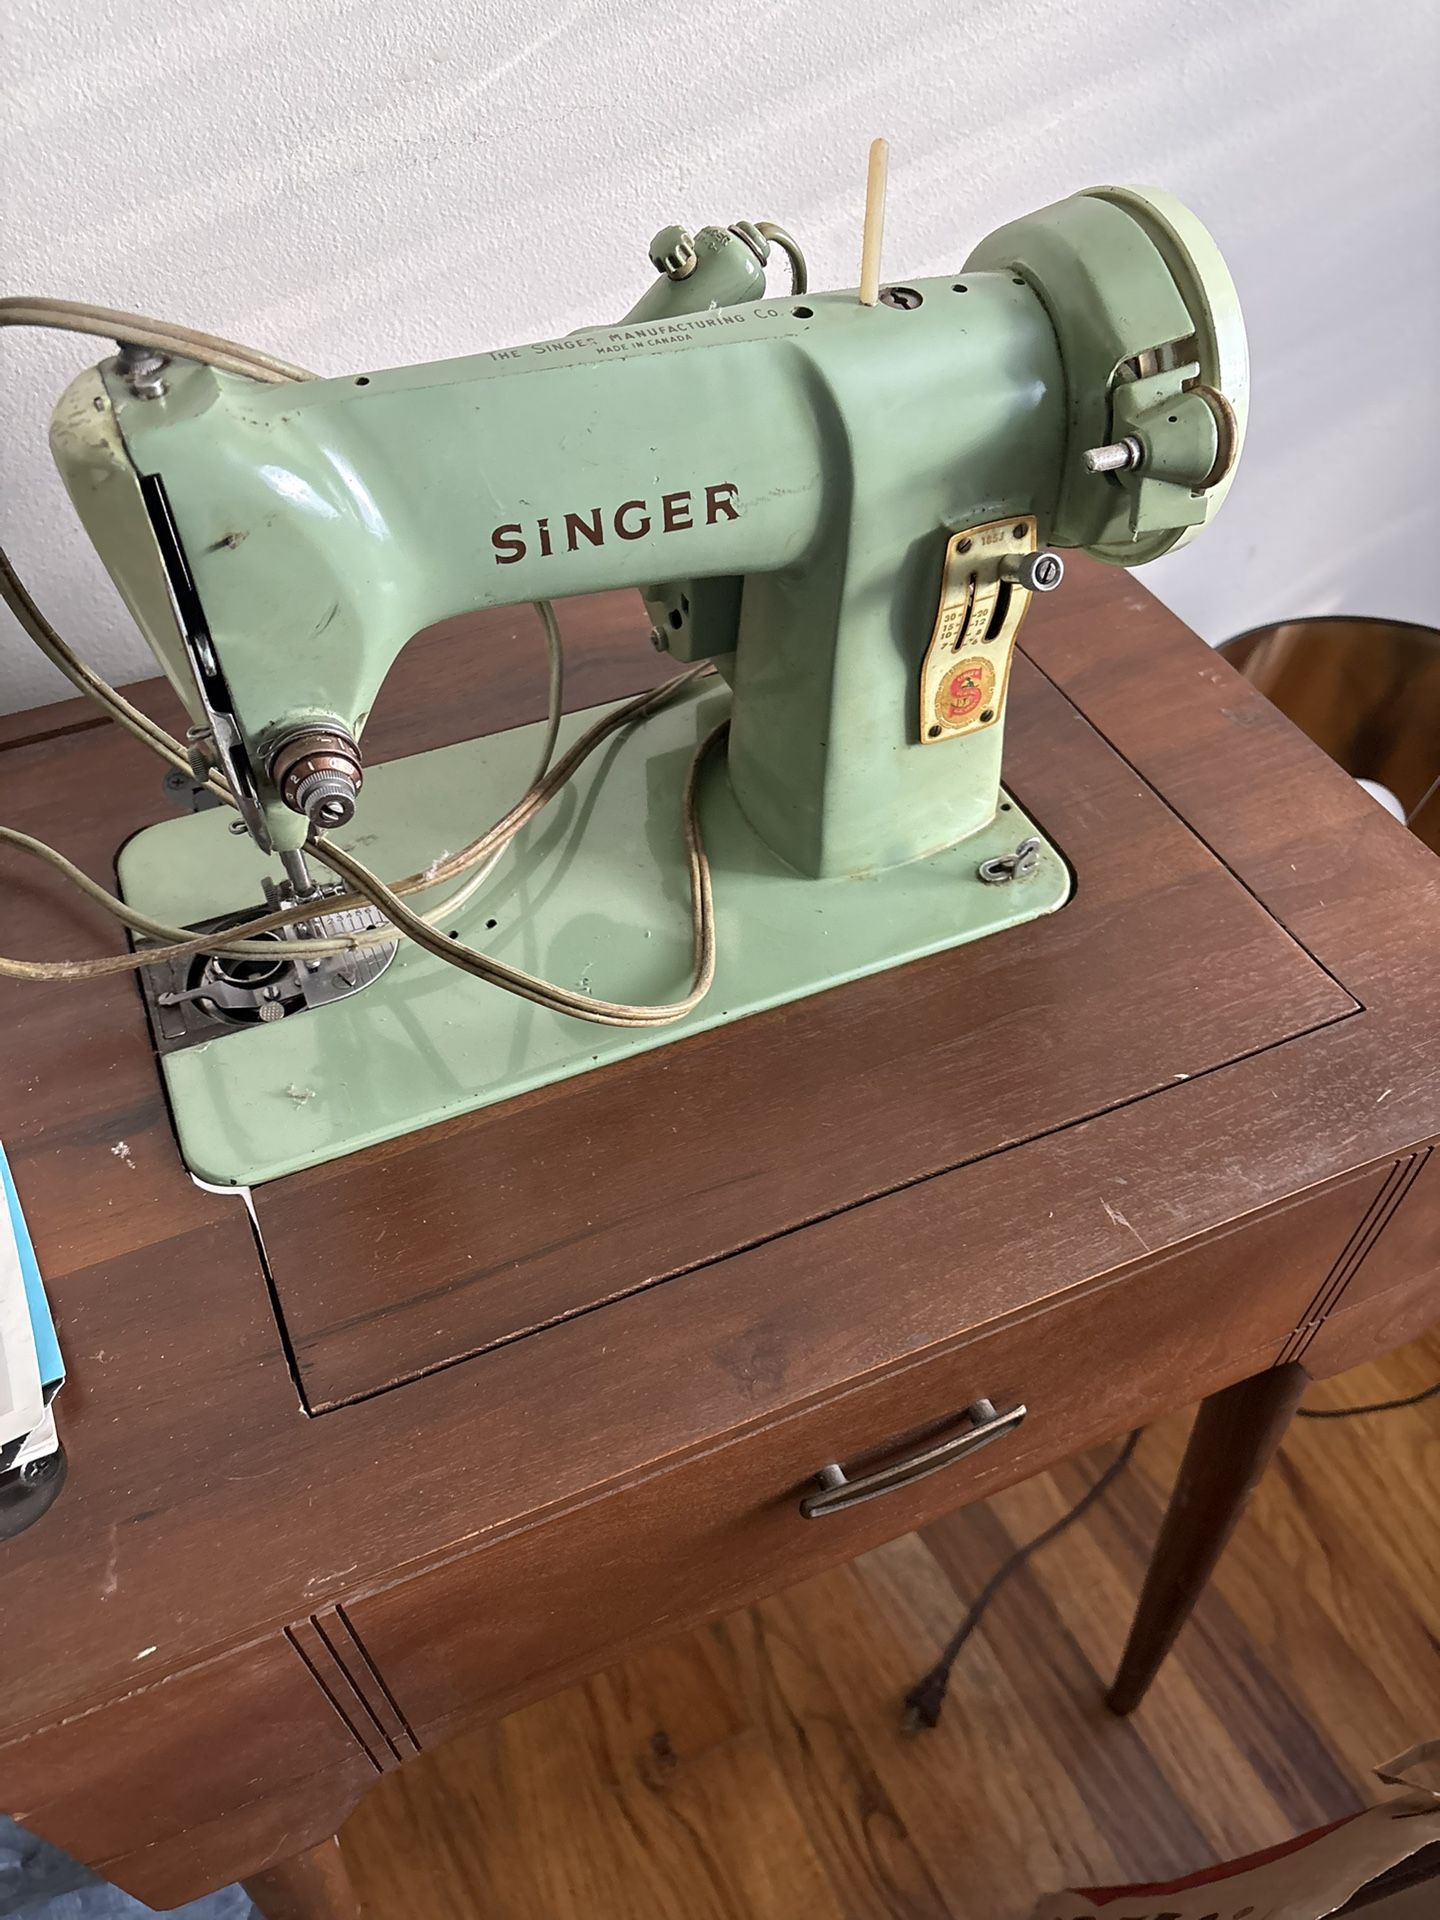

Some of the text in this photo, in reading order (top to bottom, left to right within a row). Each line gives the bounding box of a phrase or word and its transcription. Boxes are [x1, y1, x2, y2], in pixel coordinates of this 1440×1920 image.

[488, 350, 521, 361] THE
[608, 314, 745, 342] MANUFACTURING
[596, 333, 693, 355] MADE IN CANADA
[491, 482, 741, 565] SINGER
